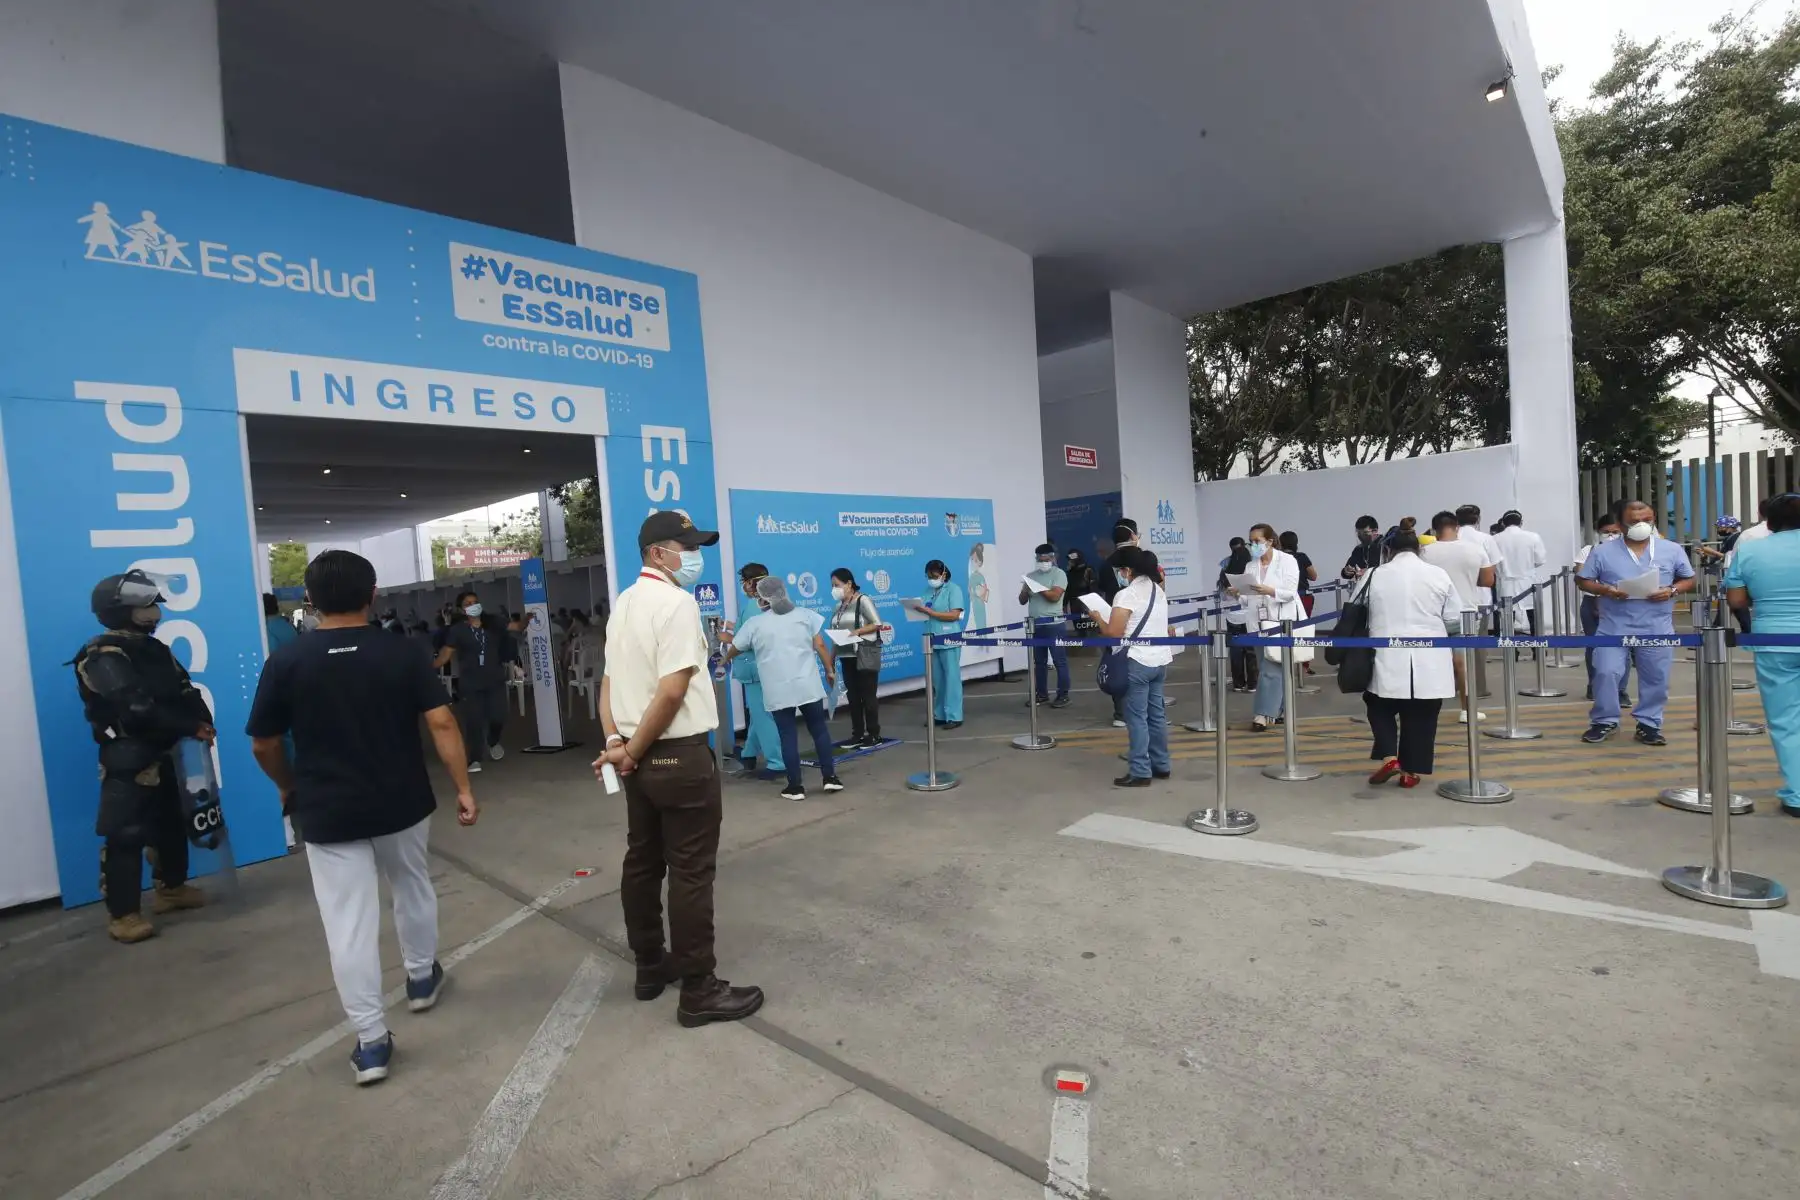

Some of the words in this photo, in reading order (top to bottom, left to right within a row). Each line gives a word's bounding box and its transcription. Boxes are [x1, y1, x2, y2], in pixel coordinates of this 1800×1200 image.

[199, 240, 376, 302] EsSalud
[460, 253, 660, 315] #Vacunarse
[501, 293, 633, 339] EsSalud
[482, 333, 549, 356] contra
[552, 340, 569, 358] la
[572, 343, 654, 369] COVID-19
[289, 369, 577, 424] INGRESO
[1068, 456, 1093, 464] EMERGENCIA
[1070, 449, 1084, 457] SALIDA
[779, 520, 819, 534] EsSalud
[841, 514, 927, 525] #VacunarseEsSalud
[854, 528, 878, 537] contra
[879, 528, 886, 537] la
[886, 528, 919, 537] COVID-19
[1150, 527, 1184, 545] EsSalud
[1515, 640, 1549, 648] EsSalud
[1642, 638, 1681, 647] EsSalud
[532, 636, 543, 681] Espera
[539, 635, 549, 669] Zona
[543, 671, 552, 687] de
